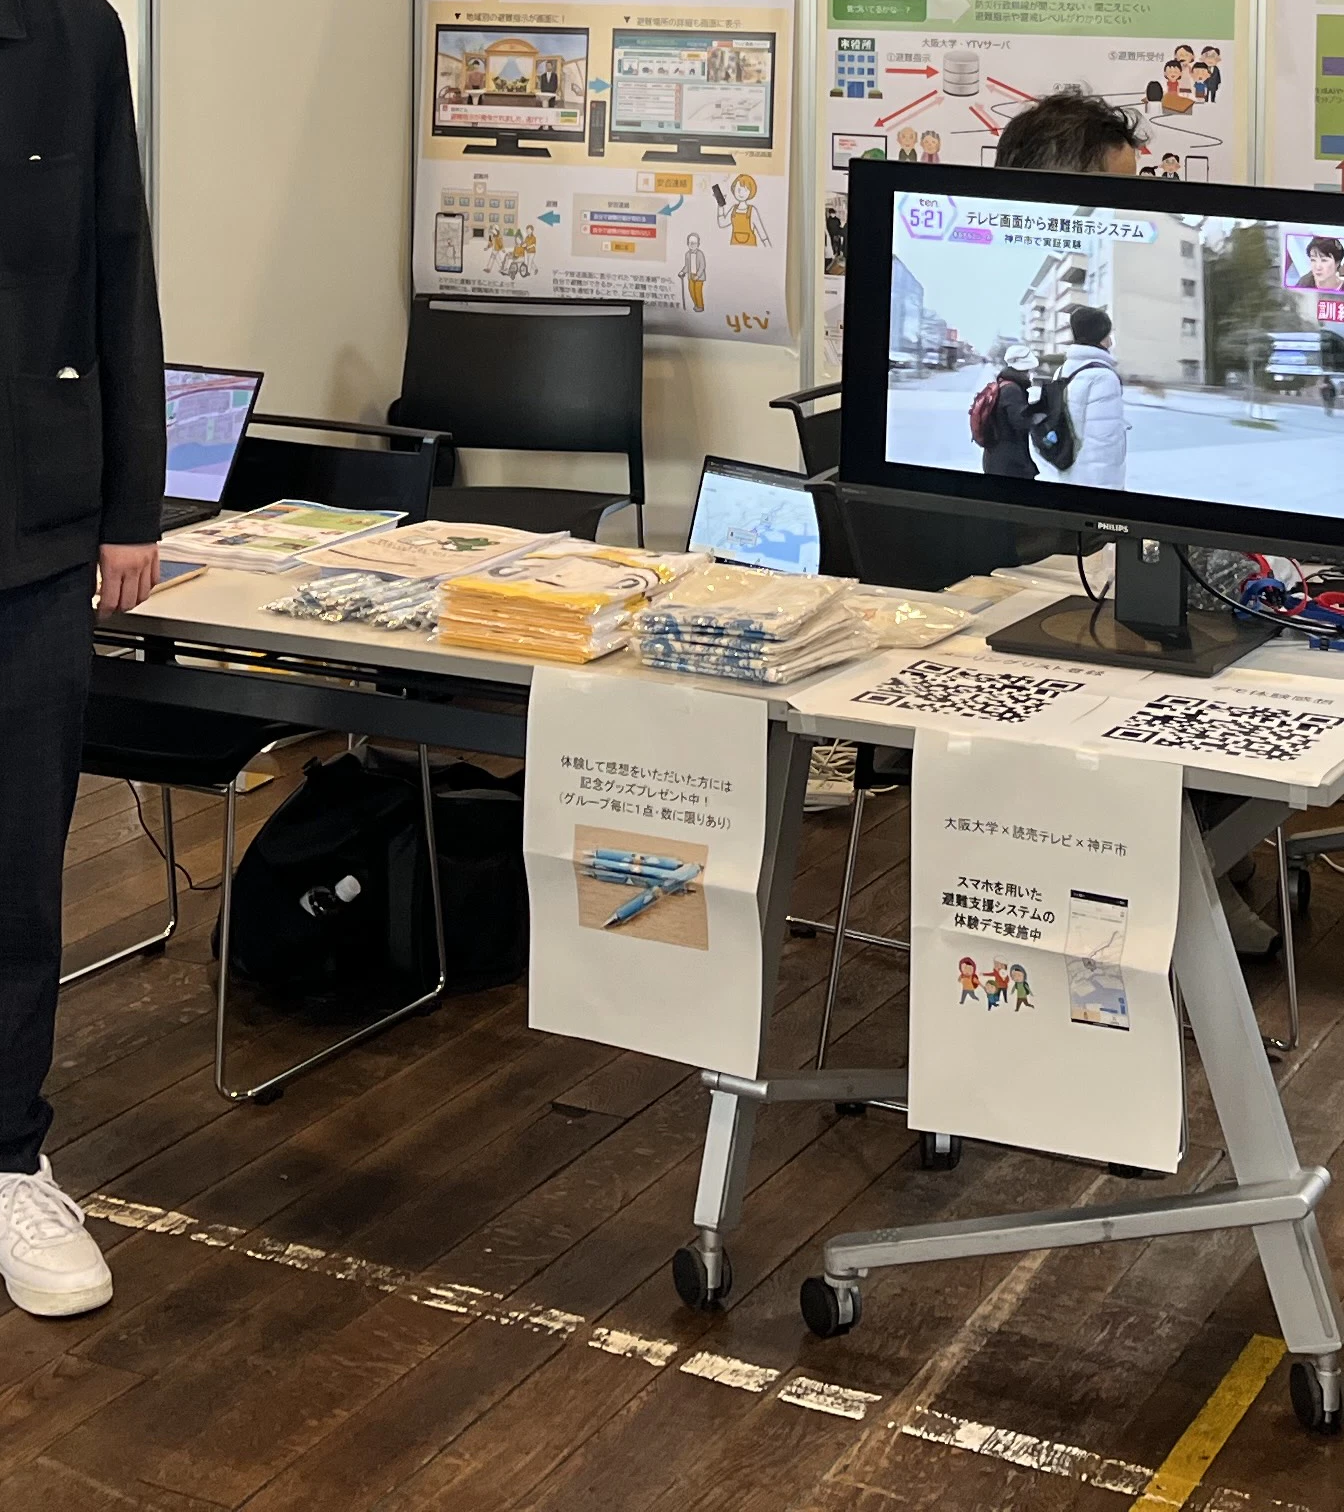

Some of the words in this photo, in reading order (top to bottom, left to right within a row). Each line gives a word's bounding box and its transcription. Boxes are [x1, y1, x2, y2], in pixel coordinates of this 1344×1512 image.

[920, 199, 939, 208] ten
[910, 209, 943, 229] 5:21
[966, 212, 1144, 238] テレビ画面から避難指示システム
[1097, 522, 1129, 533] PHILIPS
[561, 755, 732, 793] 体験して感想をいただいた方には
[957, 876, 1043, 902] スマホを用いた
[942, 892, 1055, 923] 避難支援システムの
[954, 913, 1042, 942] 体験デモ実施中
